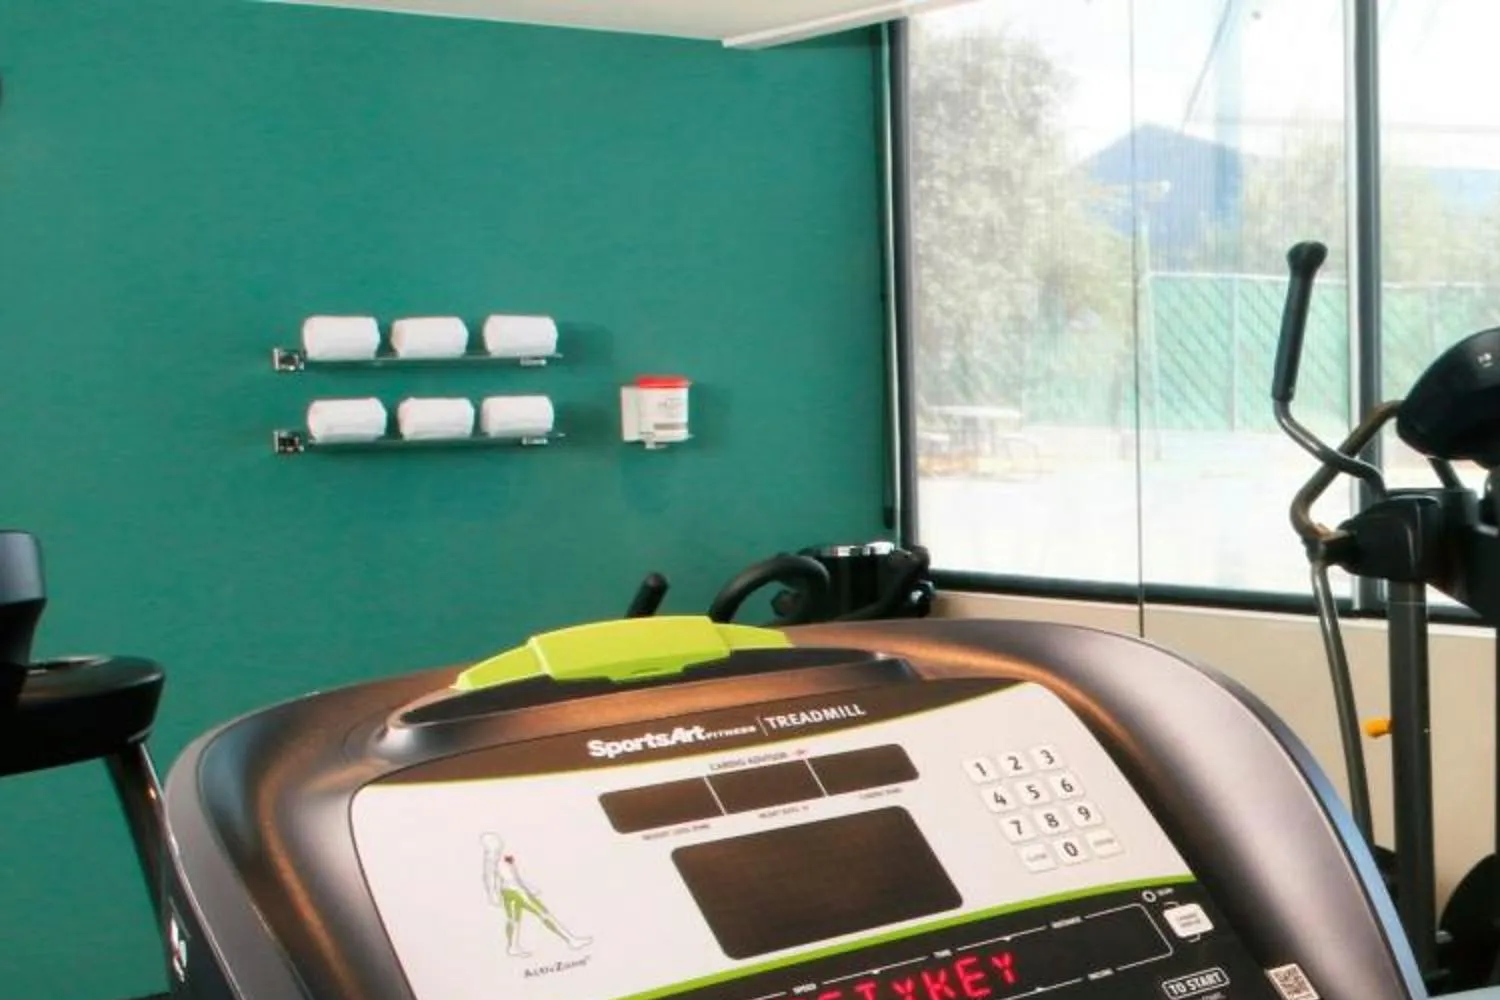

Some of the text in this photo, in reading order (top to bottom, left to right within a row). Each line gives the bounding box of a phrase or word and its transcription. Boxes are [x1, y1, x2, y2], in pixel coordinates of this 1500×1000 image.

[586, 724, 707, 759] SportsArt
[765, 704, 866, 729] TREADMILL
[974, 749, 1055, 776] 1 2 3
[993, 778, 1074, 805] 4 5 6
[1009, 805, 1091, 836] 7 8 9
[1063, 841, 1078, 857] 0
[1168, 971, 1223, 996] TO START
